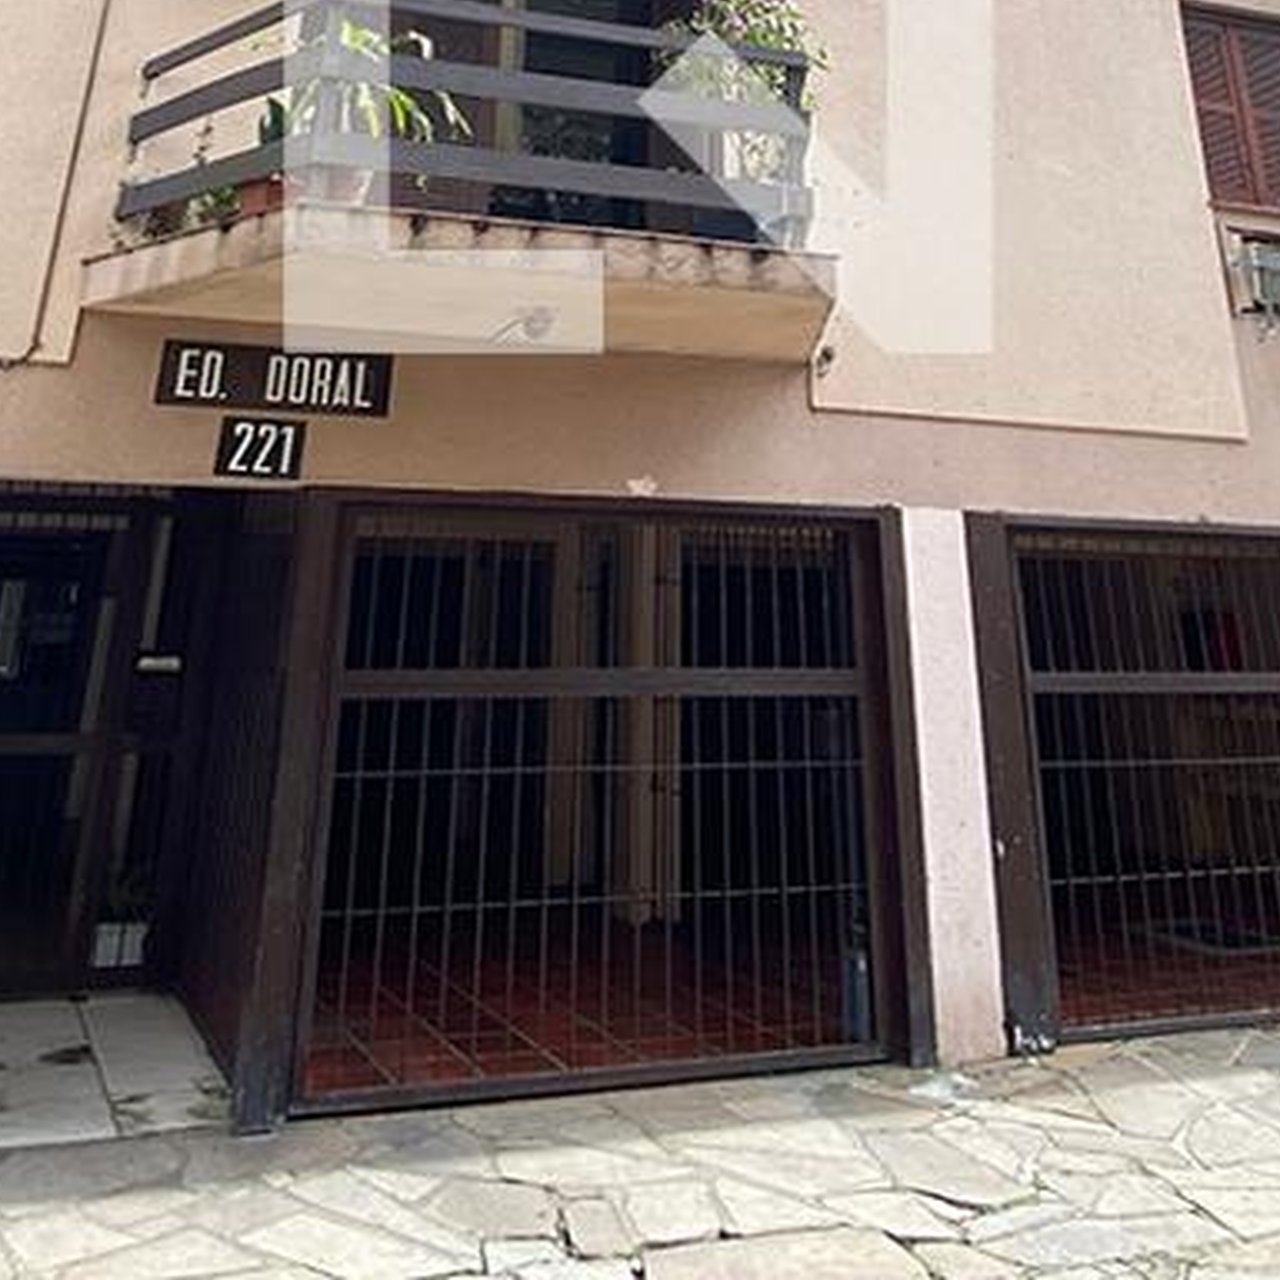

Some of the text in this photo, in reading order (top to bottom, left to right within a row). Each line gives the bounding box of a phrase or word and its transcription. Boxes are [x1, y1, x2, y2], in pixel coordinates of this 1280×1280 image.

[174, 348, 373, 408] ED. DORAL
[227, 421, 296, 476] 221
